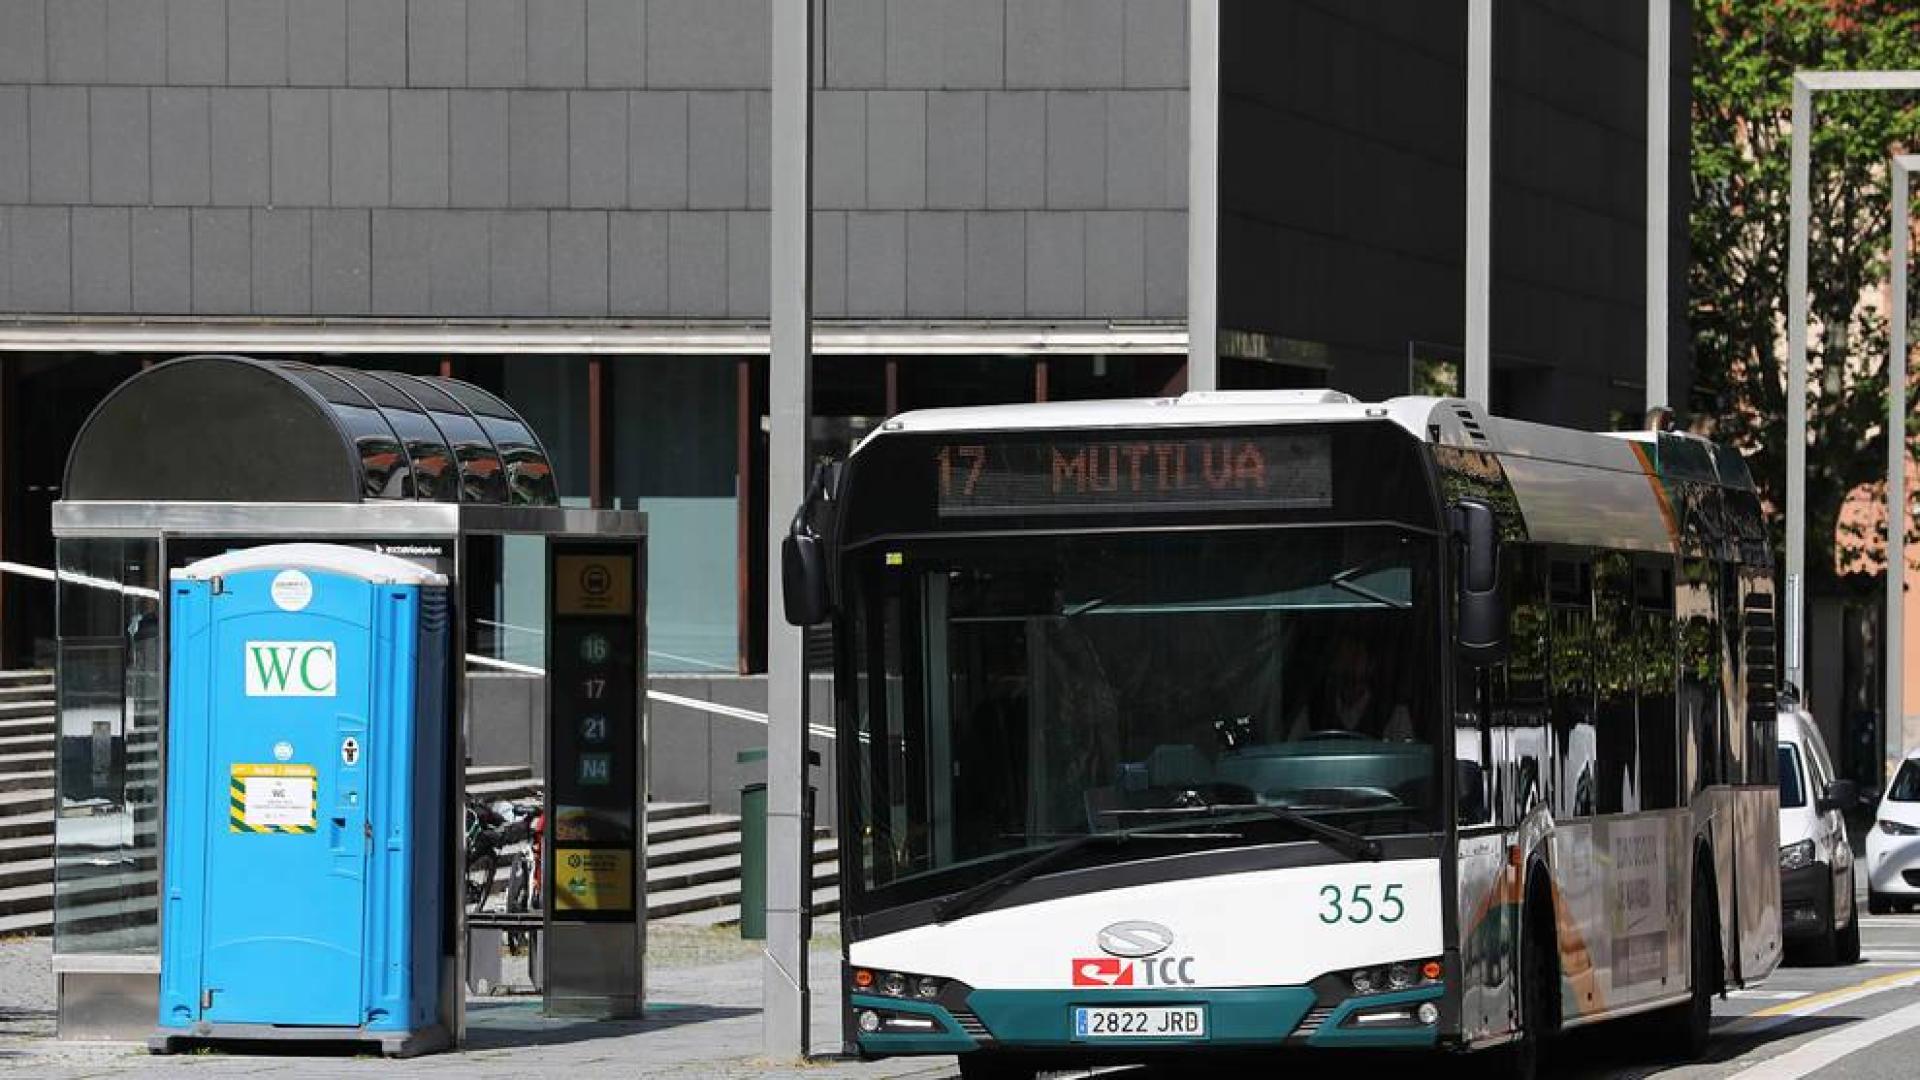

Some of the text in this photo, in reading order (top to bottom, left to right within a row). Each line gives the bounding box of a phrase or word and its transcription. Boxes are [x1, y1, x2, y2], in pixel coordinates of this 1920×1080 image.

[934, 442, 1267, 496] 17 MUTILVA
[582, 636, 606, 660] 16
[250, 646, 332, 692] WC
[584, 680, 606, 699] 17
[584, 717, 606, 738] 21
[583, 760, 607, 777] N4
[1319, 884, 1404, 923] 355
[1141, 957, 1195, 985] TCC
[1093, 1012, 1148, 1032] 2822
[1158, 1012, 1198, 1032] JRD
